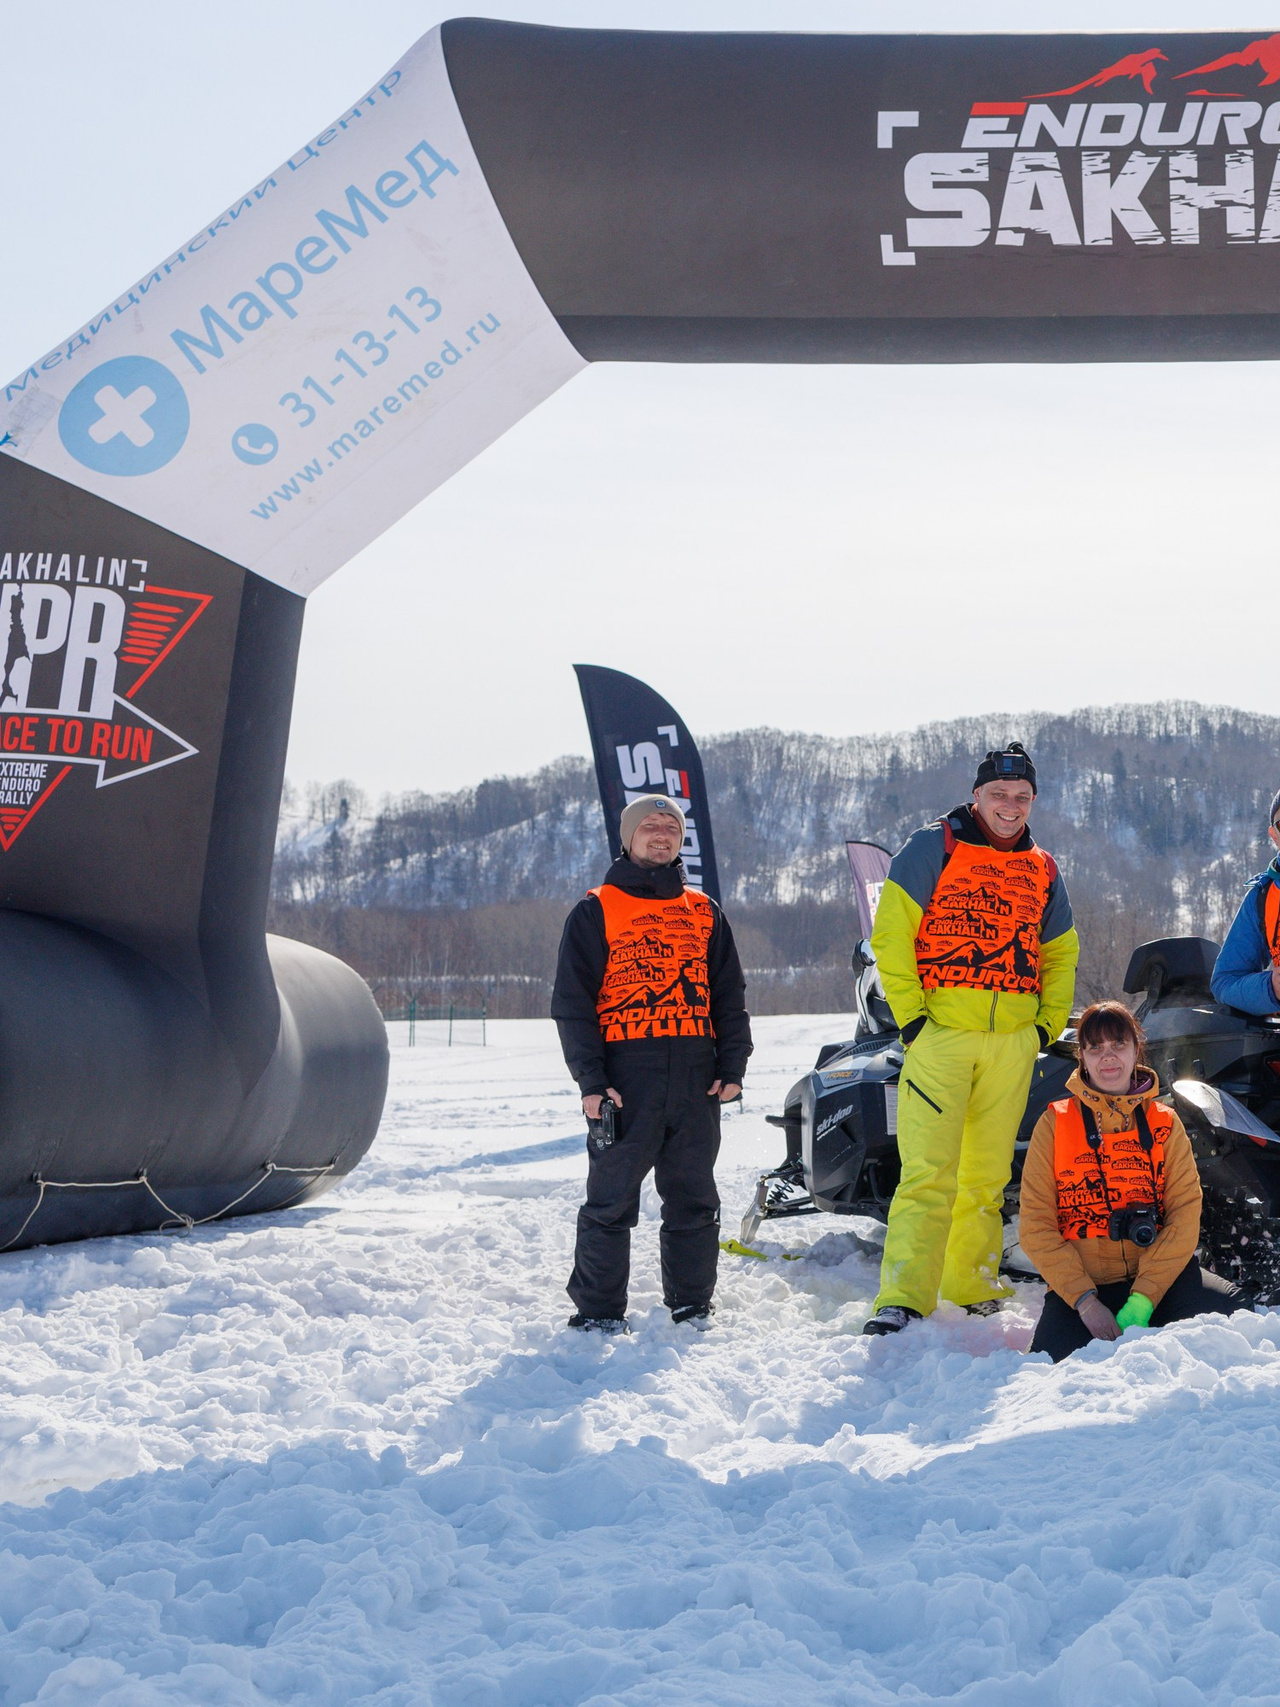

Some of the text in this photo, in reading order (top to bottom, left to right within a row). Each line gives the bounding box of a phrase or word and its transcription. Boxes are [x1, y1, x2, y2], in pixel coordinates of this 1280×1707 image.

[286, 70, 402, 172] Центр
[169, 139, 460, 376] МареМед
[277, 285, 443, 429] 31-13-13
[248, 309, 503, 521] www.maremed.ru
[0, 551, 128, 587] AKHALIN
[47, 717, 84, 754] TO
[89, 725, 154, 763] RUN
[0, 777, 41, 792] NDURO
[940, 899, 1010, 917] SAKHALIN
[928, 923, 996, 940] SAKHALIN
[611, 947, 673, 963] SAKHALIN
[606, 970, 664, 988] SAKHALIN
[917, 964, 1021, 989] ENDURO
[599, 1005, 694, 1026] ENDURO
[816, 1104, 854, 1136] ski-doo
[1058, 1190, 1119, 1208] AKHALIN
